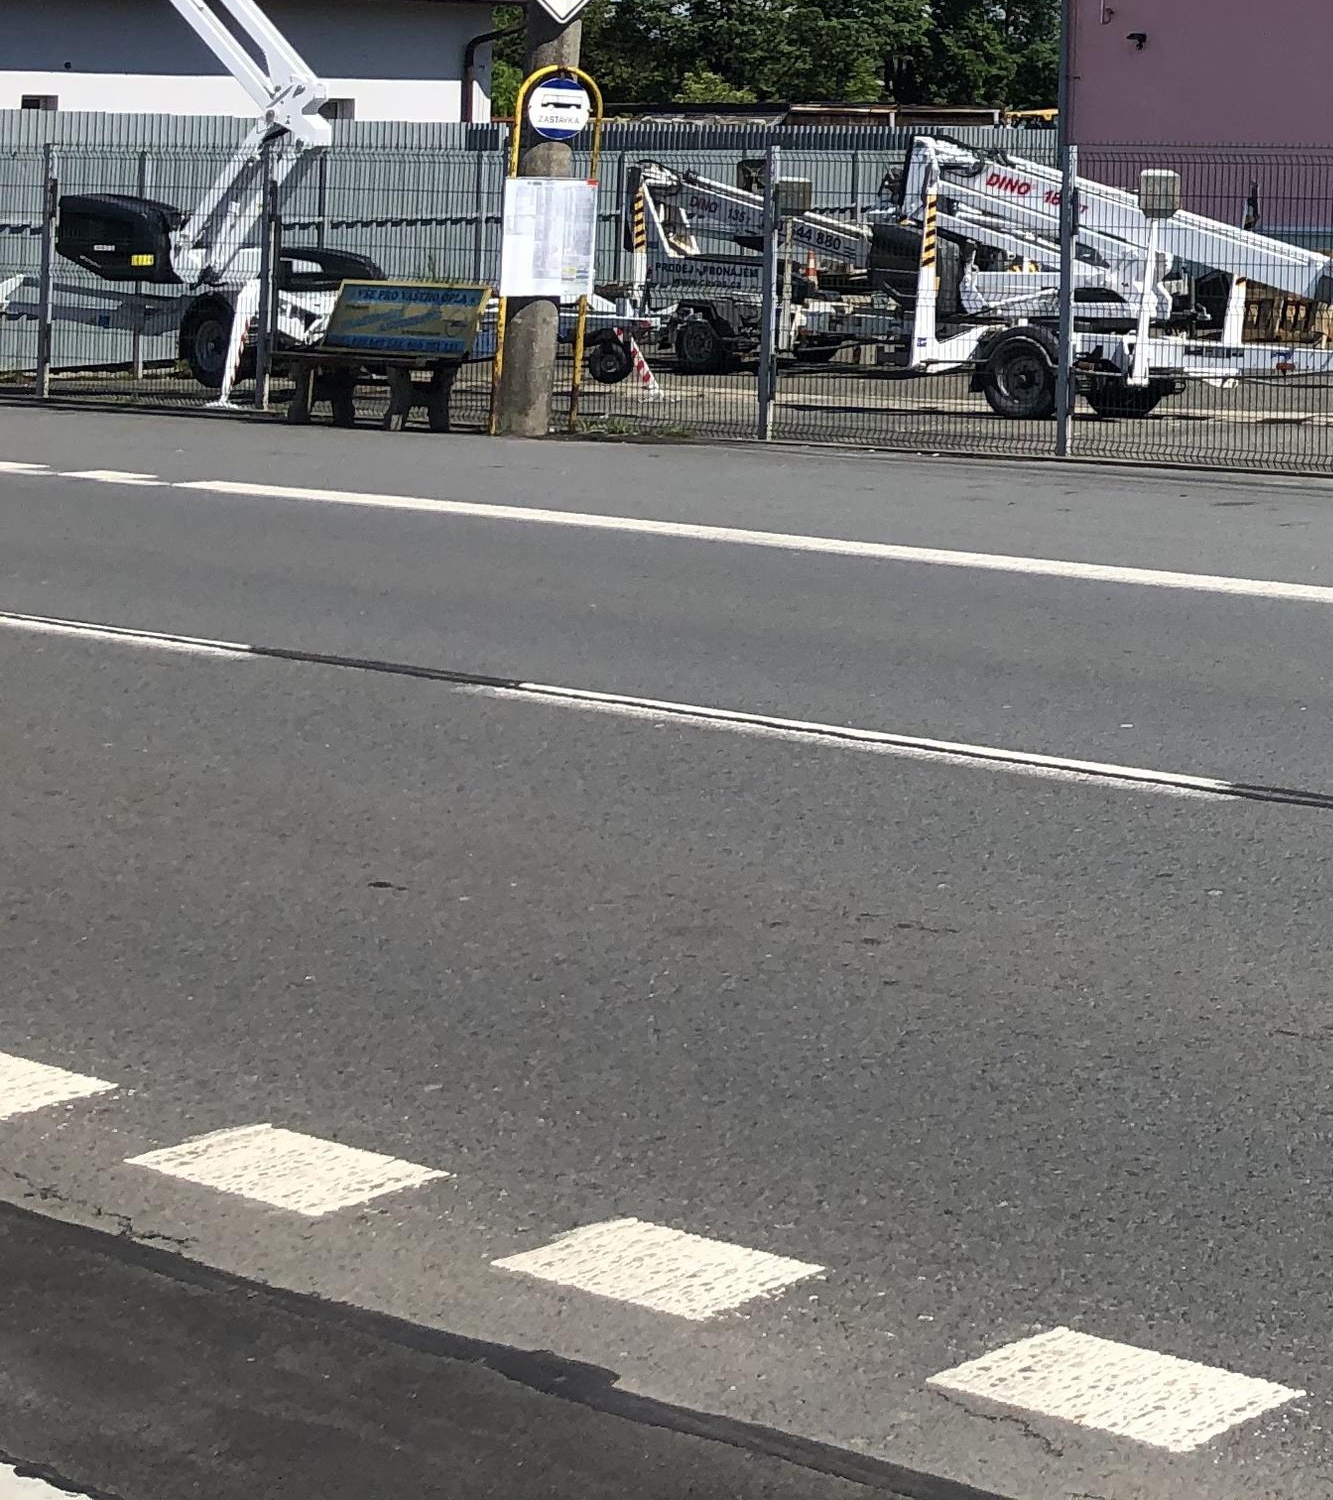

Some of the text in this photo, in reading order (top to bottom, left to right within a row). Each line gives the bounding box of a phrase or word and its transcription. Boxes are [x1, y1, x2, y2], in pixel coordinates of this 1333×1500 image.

[986, 173, 1031, 195] DINO
[689, 196, 718, 213] DINO
[816, 231, 842, 250] 880
